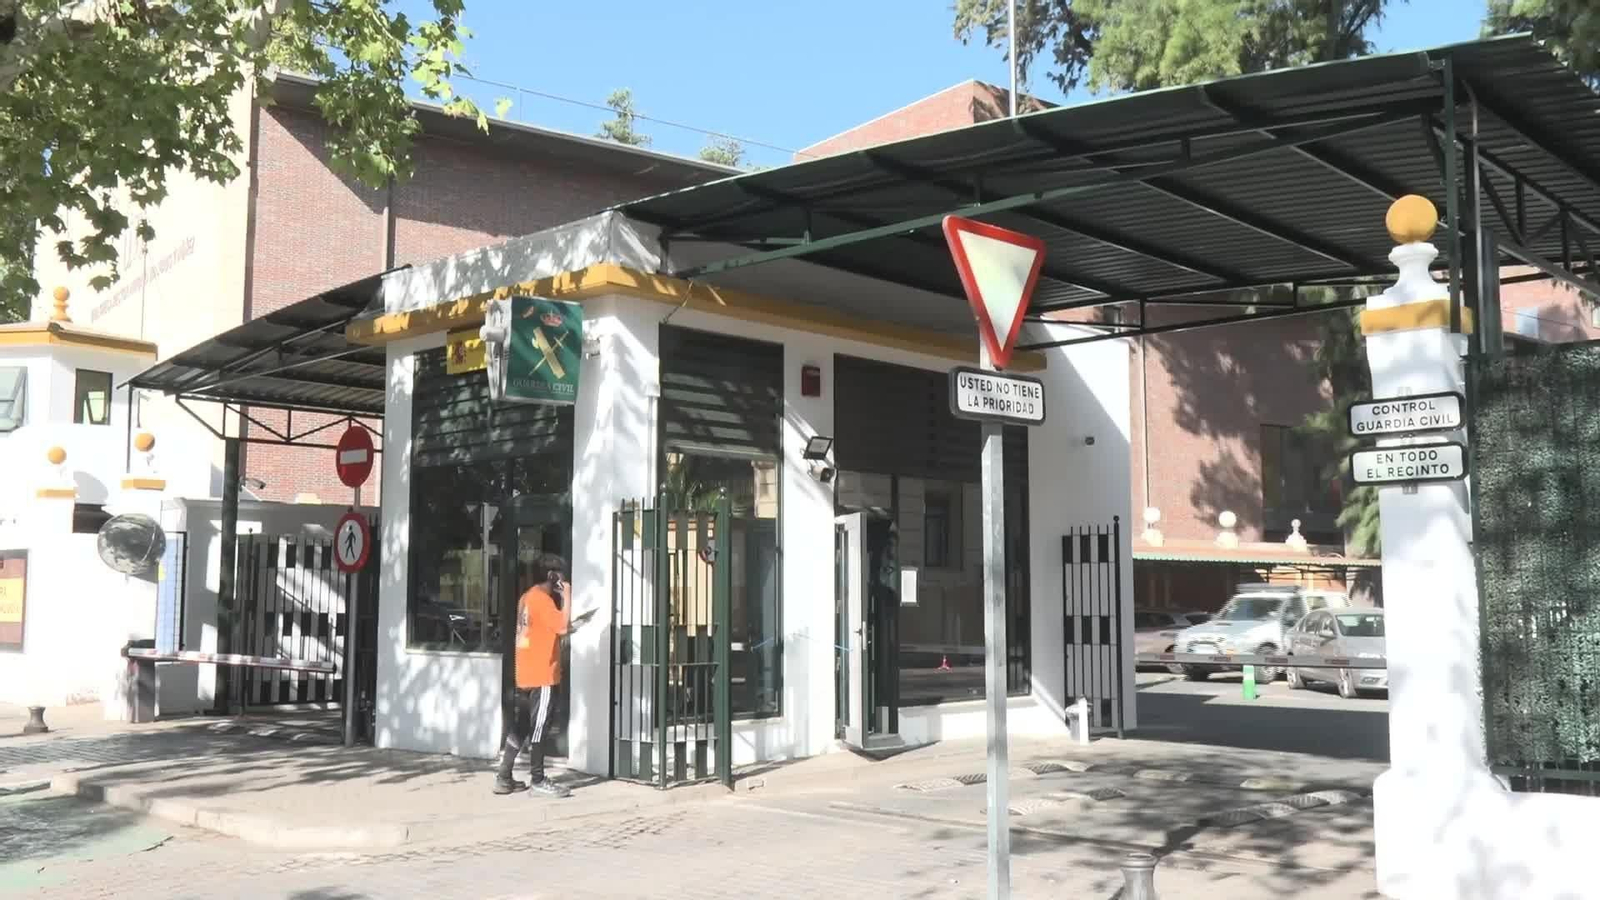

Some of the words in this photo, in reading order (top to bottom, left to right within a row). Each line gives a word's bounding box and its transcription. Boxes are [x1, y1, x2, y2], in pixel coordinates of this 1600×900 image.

[552, 382, 575, 393] CIVIL
[960, 378, 992, 392] USTED
[996, 381, 1010, 394] NO
[1013, 384, 1040, 399] TIENE
[967, 395, 979, 407] LA
[983, 397, 1034, 414] PRIORIDAD
[1372, 401, 1436, 415] CONTROL
[1356, 418, 1416, 432] GUARDIA
[1419, 413, 1454, 426] CIVIL
[1377, 453, 1394, 464] EN
[1400, 450, 1438, 462] TODO
[1367, 468, 1382, 479] EL
[1388, 463, 1449, 477] RECINTO
